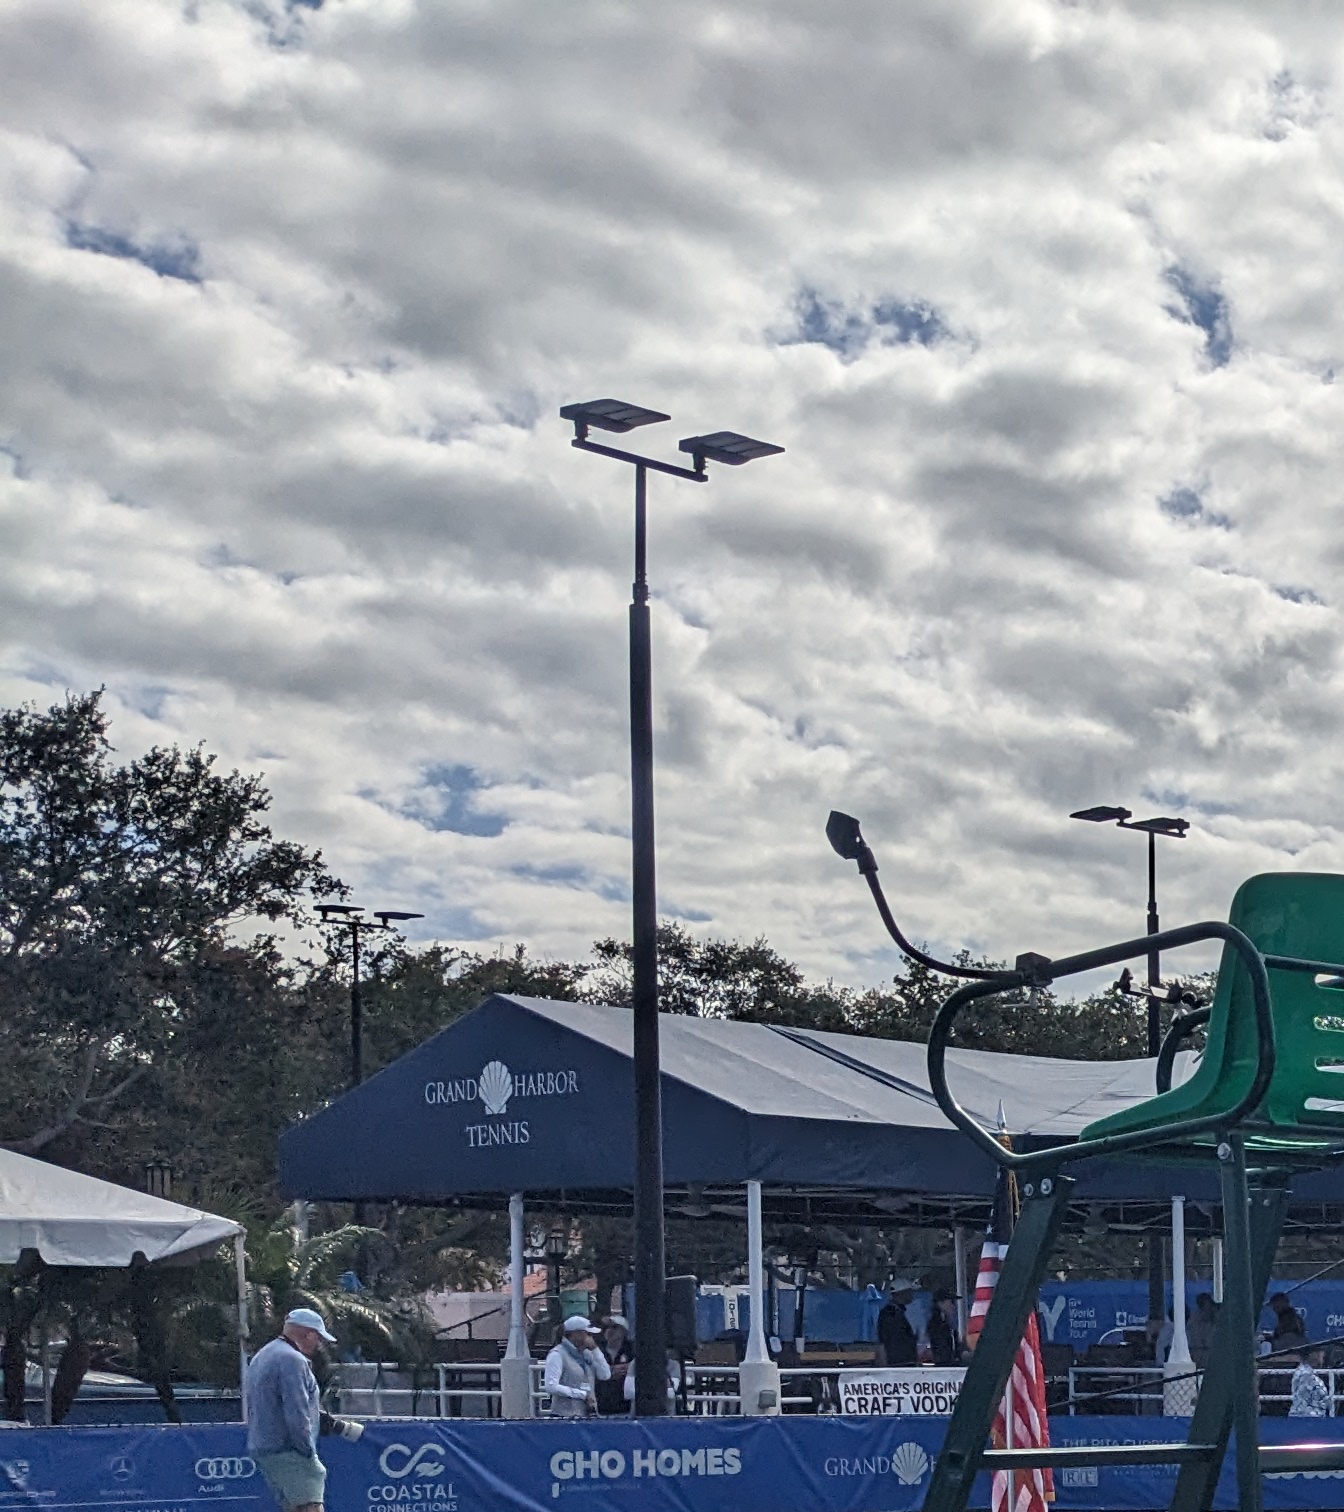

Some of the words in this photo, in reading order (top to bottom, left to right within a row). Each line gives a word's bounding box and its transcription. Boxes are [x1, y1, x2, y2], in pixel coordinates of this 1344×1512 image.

[424, 1079, 478, 1104] GRAND
[514, 1070, 580, 1097] HARBOR
[466, 1121, 530, 1147] TENNIS
[843, 1382, 910, 1396] AMERICA'S
[913, 1381, 963, 1395] ORIGIN
[844, 1396, 904, 1415] CRAFT
[909, 1395, 960, 1414] VODK
[550, 1449, 626, 1480] GHO
[632, 1447, 742, 1477] HOMES
[824, 1457, 891, 1477] GRAND
[198, 1483, 225, 1493] Audi
[367, 1483, 458, 1502] COASTAL
